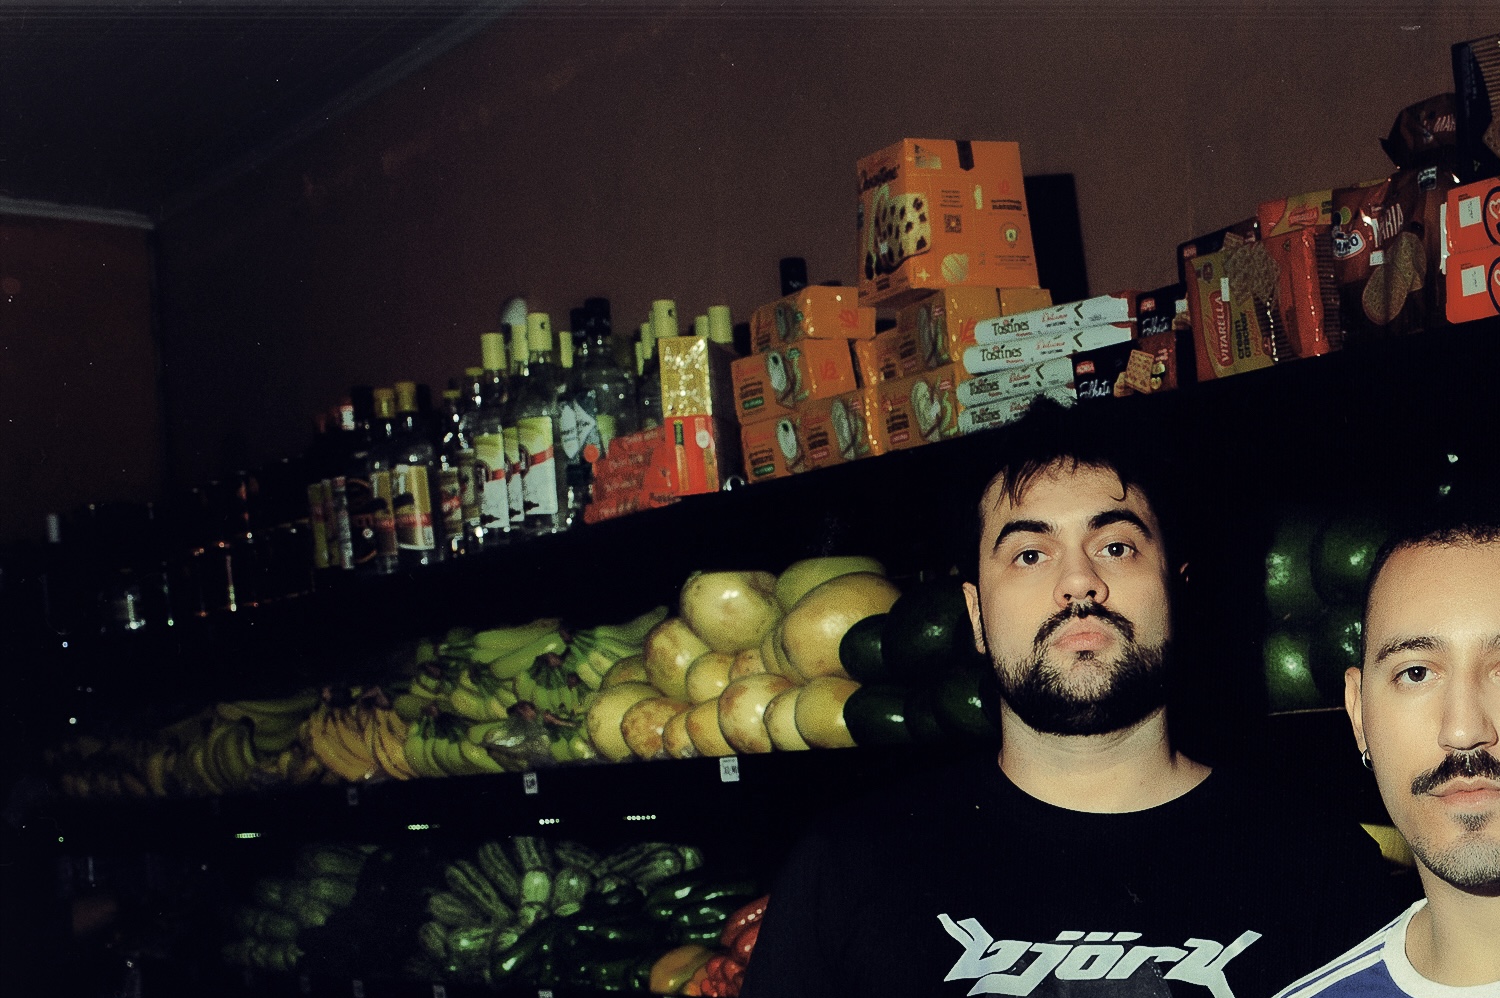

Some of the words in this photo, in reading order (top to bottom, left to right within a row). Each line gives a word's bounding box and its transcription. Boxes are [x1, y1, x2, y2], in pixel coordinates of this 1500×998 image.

[991, 318, 1030, 337] Tostines
[1214, 296, 1230, 362] VITARELLA
[980, 345, 1023, 363] Tostines
